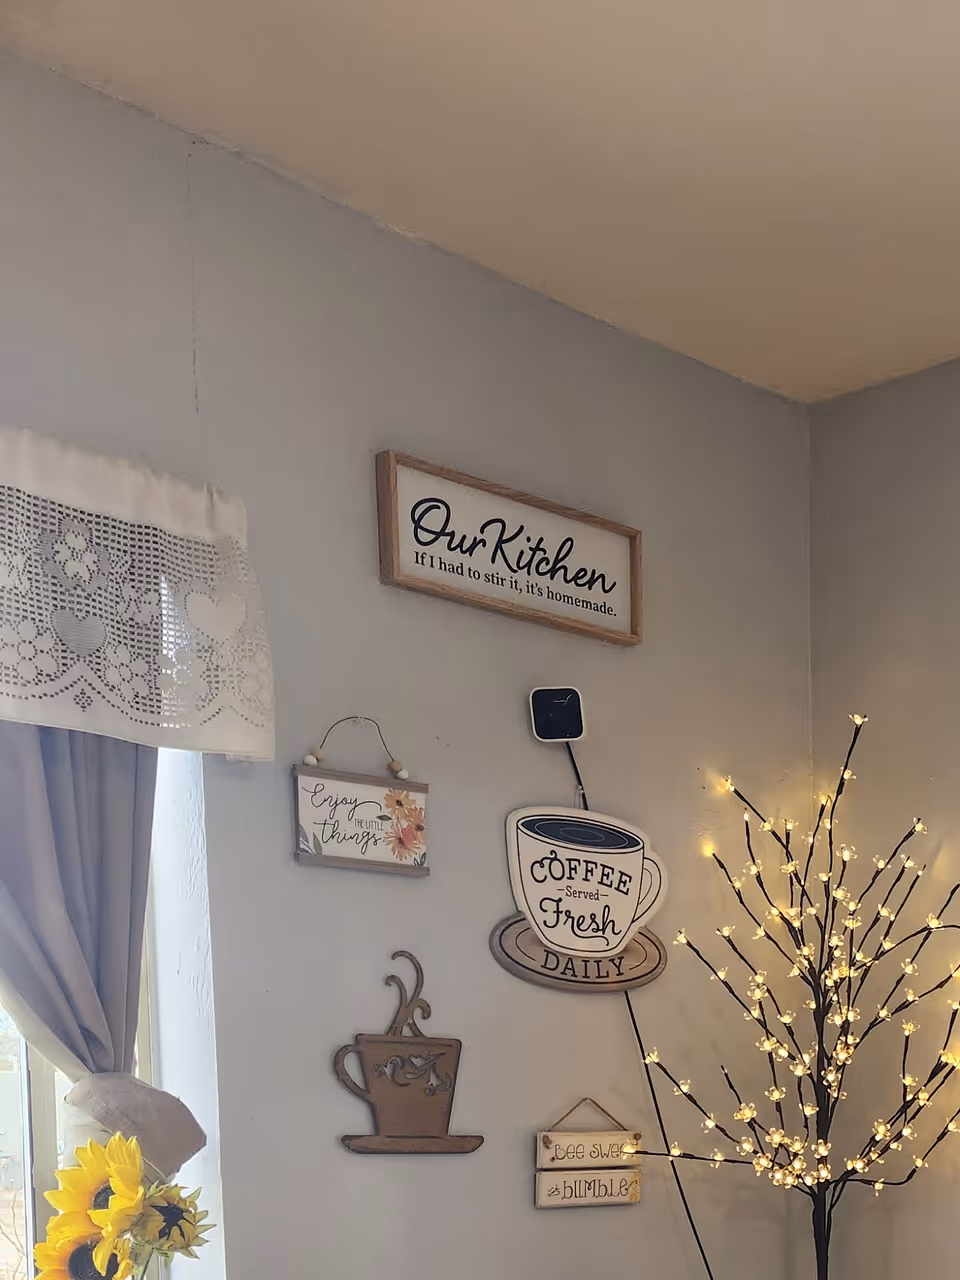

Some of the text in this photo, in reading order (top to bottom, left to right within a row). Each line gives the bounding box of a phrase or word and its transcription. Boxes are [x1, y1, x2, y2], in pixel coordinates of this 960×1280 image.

[411, 497, 616, 594] Our Kitchen
[414, 551, 617, 617] If I had to stir it, it's homemade.
[302, 783, 382, 821] Enjoy
[354, 818, 364, 829] THE
[530, 850, 632, 896] COFFEE
[539, 897, 622, 946] Fresh
[540, 949, 625, 979] DAILY
